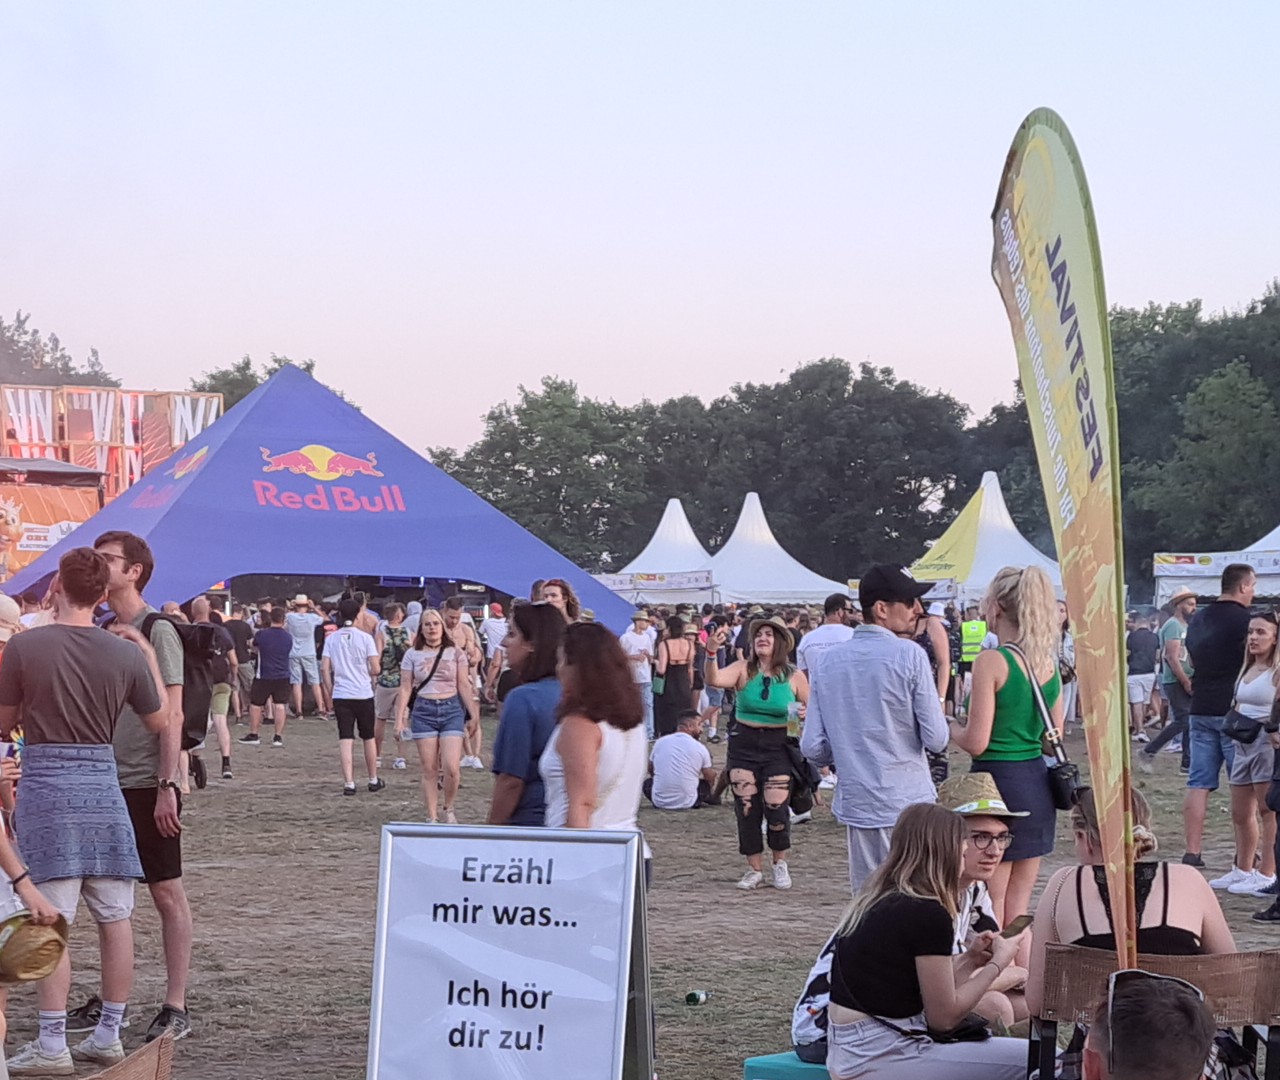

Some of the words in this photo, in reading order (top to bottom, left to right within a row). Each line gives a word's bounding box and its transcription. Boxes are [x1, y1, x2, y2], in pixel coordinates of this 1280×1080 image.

[252, 480, 330, 511] Red
[331, 484, 406, 512] Bull
[462, 857, 553, 885] Erzähl
[432, 897, 483, 924] mir
[493, 905, 577, 928] was...
[448, 980, 490, 1007] Ich
[501, 981, 553, 1010] hör
[448, 1021, 490, 1048] dir
[499, 1024, 544, 1051] zu!
